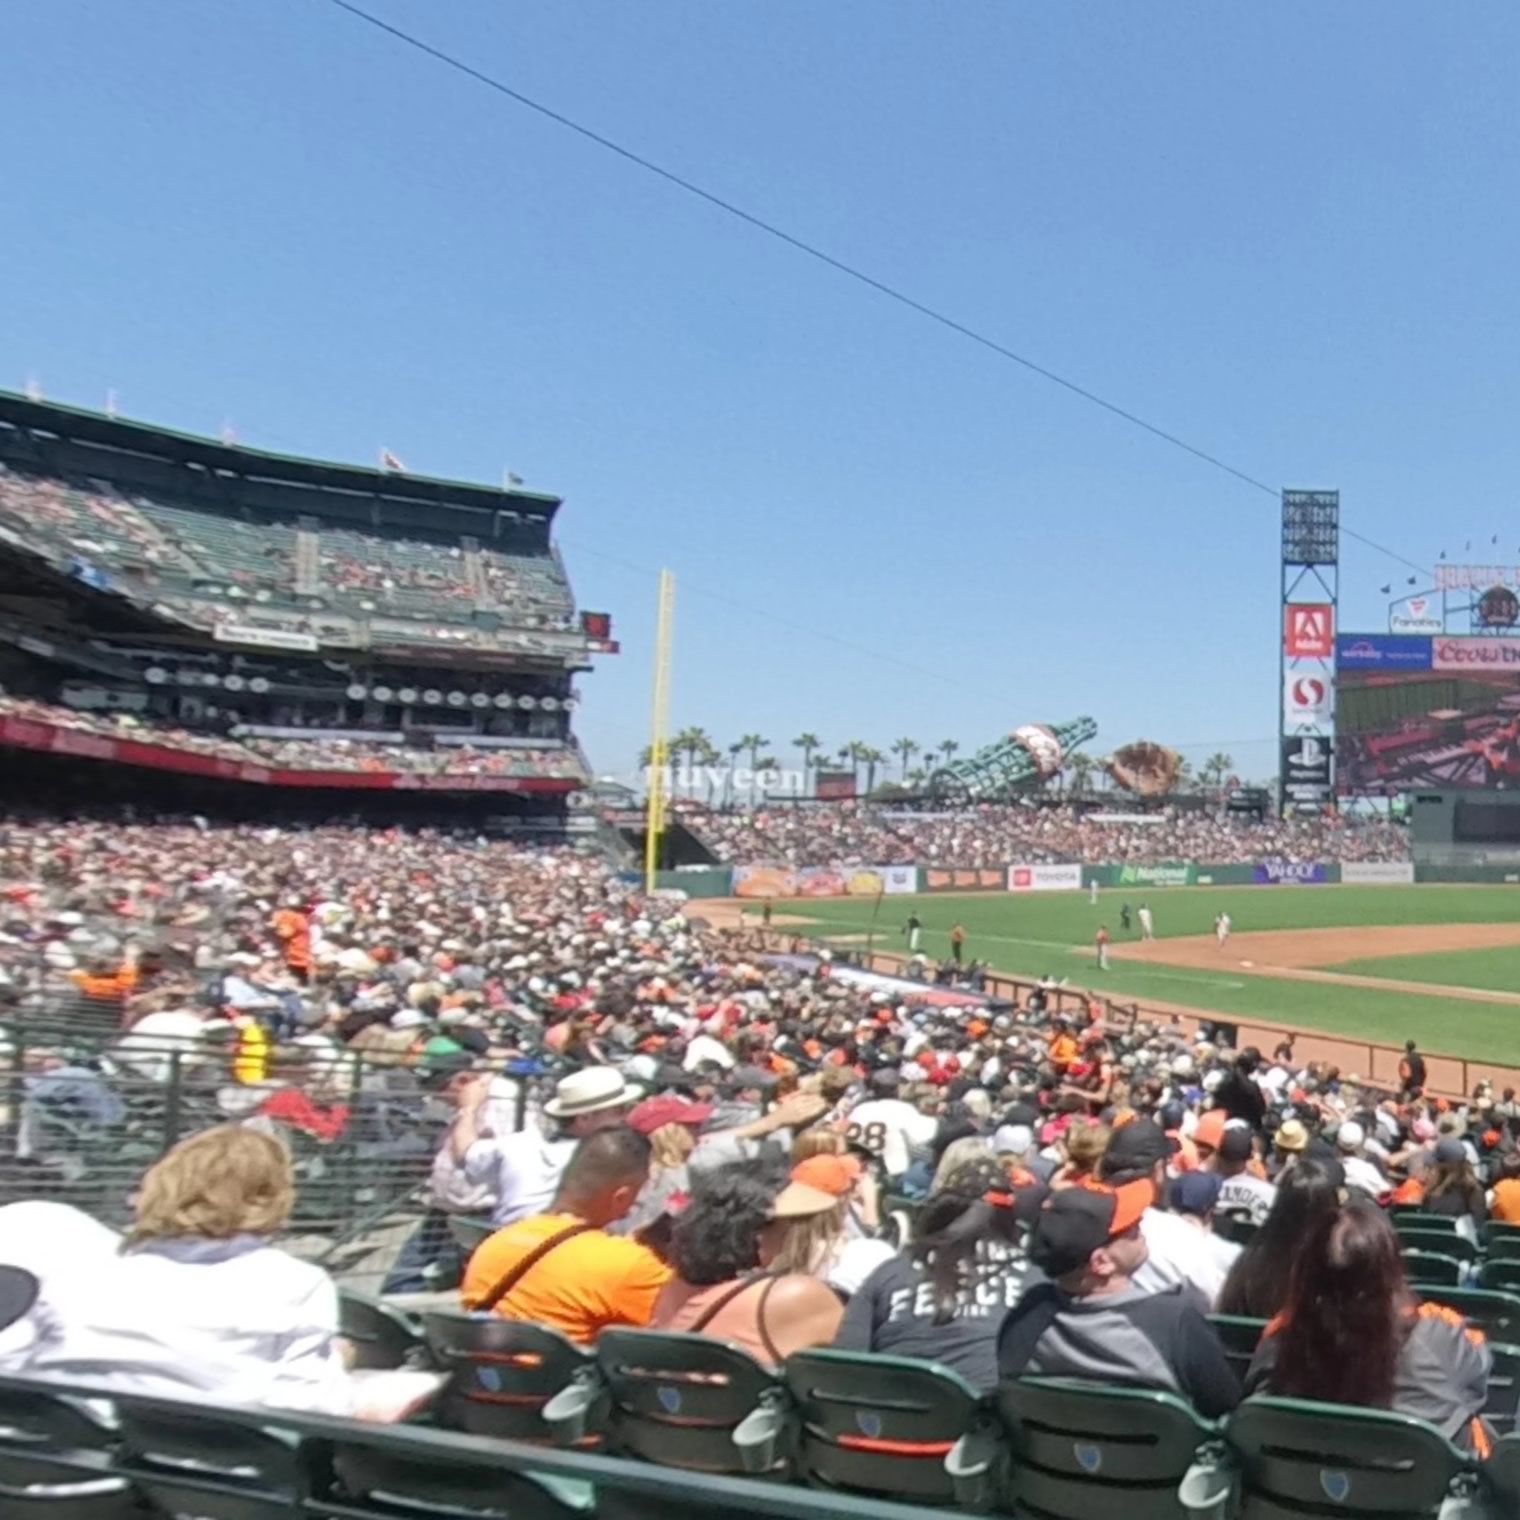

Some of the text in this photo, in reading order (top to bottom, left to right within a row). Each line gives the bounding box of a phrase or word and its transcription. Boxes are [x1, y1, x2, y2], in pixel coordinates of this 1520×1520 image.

[1392, 615, 1442, 628] Fanatics
[1036, 872, 1077, 881] TOYOTA
[1136, 866, 1188, 880] National
